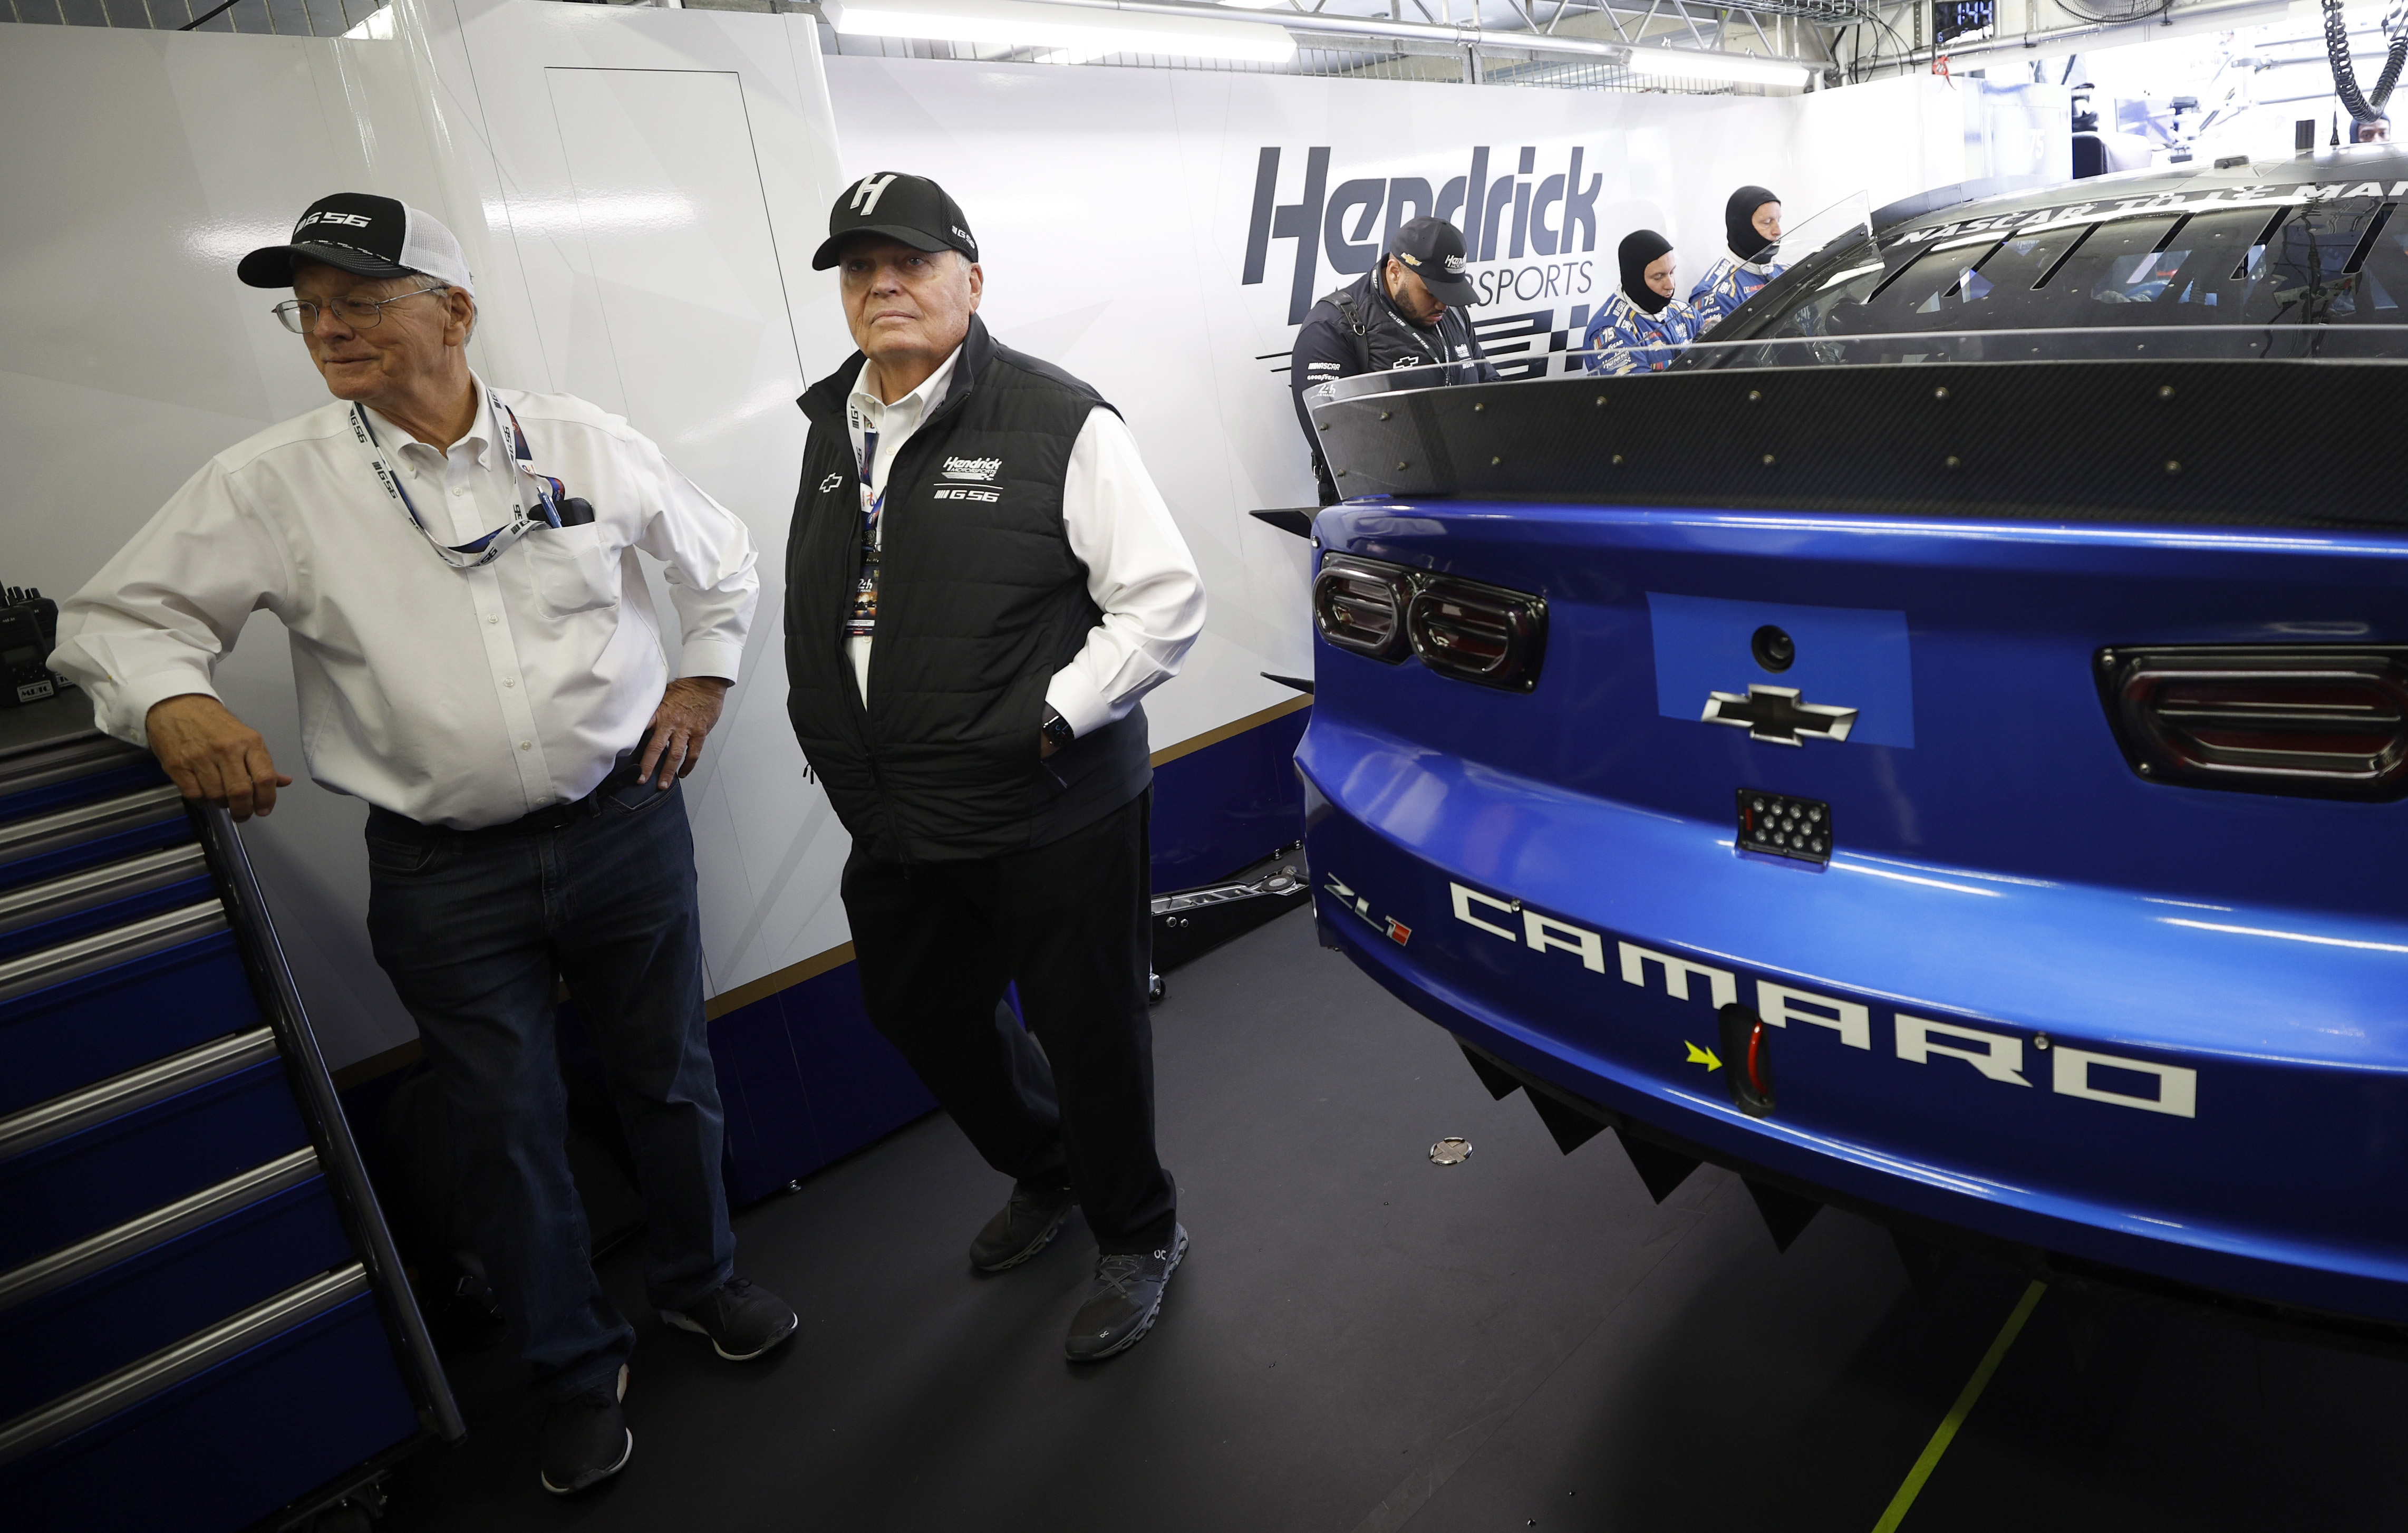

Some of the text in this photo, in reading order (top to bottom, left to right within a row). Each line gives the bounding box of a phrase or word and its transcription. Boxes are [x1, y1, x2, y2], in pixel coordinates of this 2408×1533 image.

[1957, 1, 1993, 25] 1:44
[2029, 128, 2045, 159] 75
[850, 173, 897, 216] H
[1242, 147, 1602, 325] Hendrick
[1892, 205, 2095, 246] NASCAR
[1704, 293, 1715, 306] 75
[1602, 326, 1616, 343] 75
[943, 457, 1002, 471] Hendrick
[378, 470, 398, 498] G56
[857, 579, 873, 589] 24h
[1324, 872, 1412, 947] ZL1
[1449, 881, 2197, 1119] CAMARO
